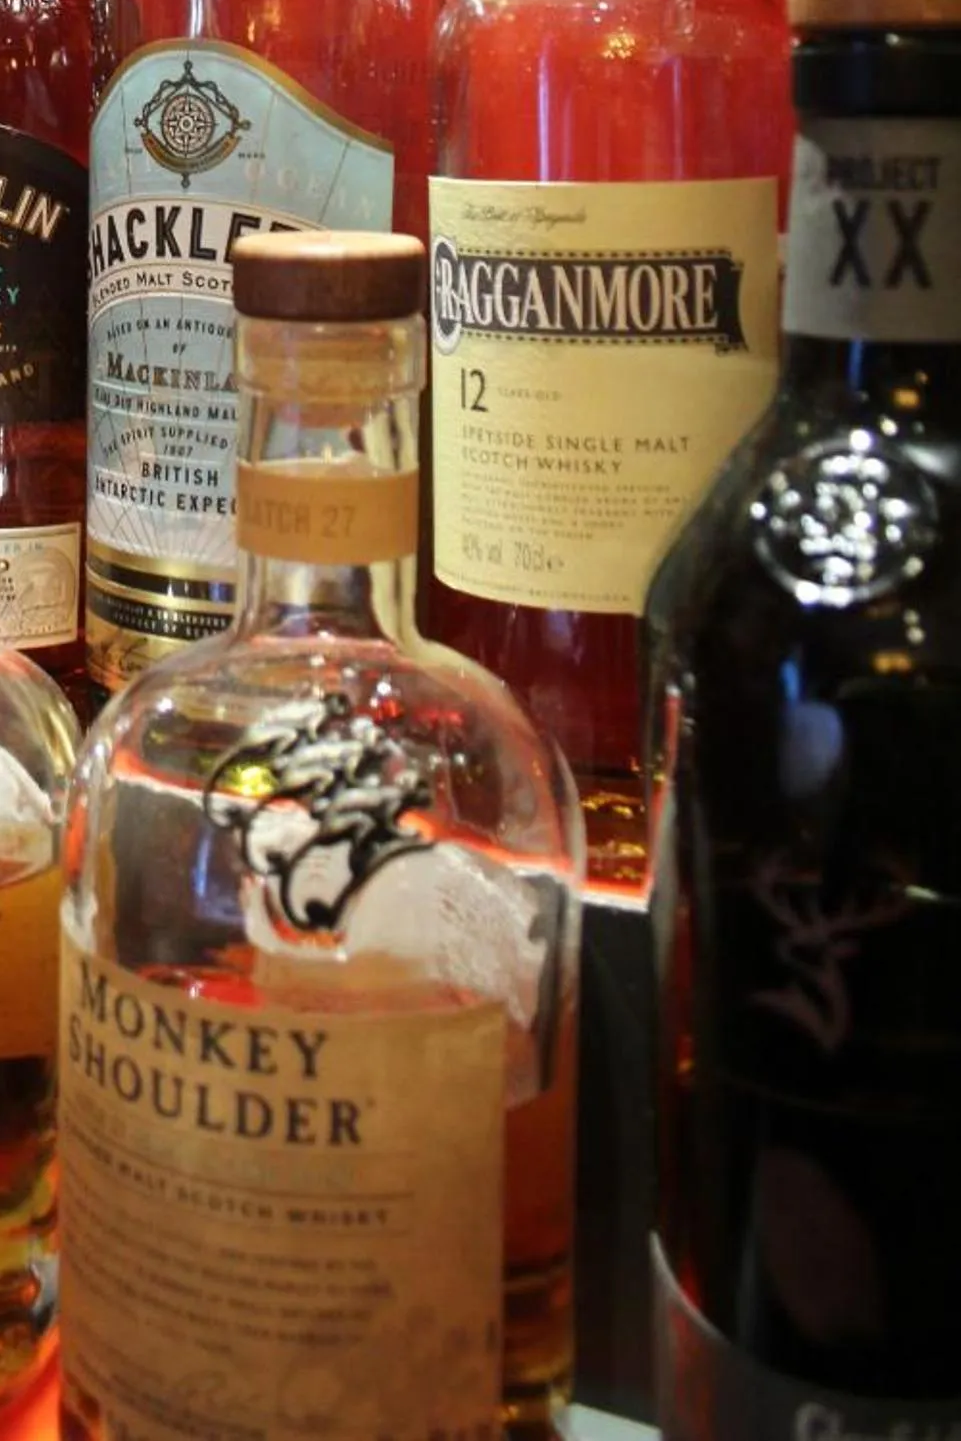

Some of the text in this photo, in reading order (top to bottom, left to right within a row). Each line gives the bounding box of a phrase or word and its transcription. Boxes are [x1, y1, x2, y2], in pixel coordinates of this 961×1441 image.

[136, 271, 175, 287] MALT
[182, 270, 232, 293] SCOT
[155, 318, 171, 330] AN
[106, 351, 239, 392] MACKINLA
[460, 367, 489, 413] 12
[137, 398, 201, 419] HIGHLAND
[207, 408, 238, 422] MAL
[120, 426, 155, 447] SPIRIT
[161, 426, 229, 451] SUPPLIED
[461, 425, 691, 454] SPEYSIDE SINGLE MALT
[141, 462, 220, 488] BRITISH
[461, 448, 624, 475] SCOTCH WHISKY
[95, 474, 166, 508] ANTARCTIC
[319, 504, 356, 540] 27
[79, 960, 330, 1081] MONKEY
[68, 1013, 364, 1147] SHOULDER
[175, 1182, 276, 1222] SCOTCH
[284, 1207, 391, 1227] WHISKY
